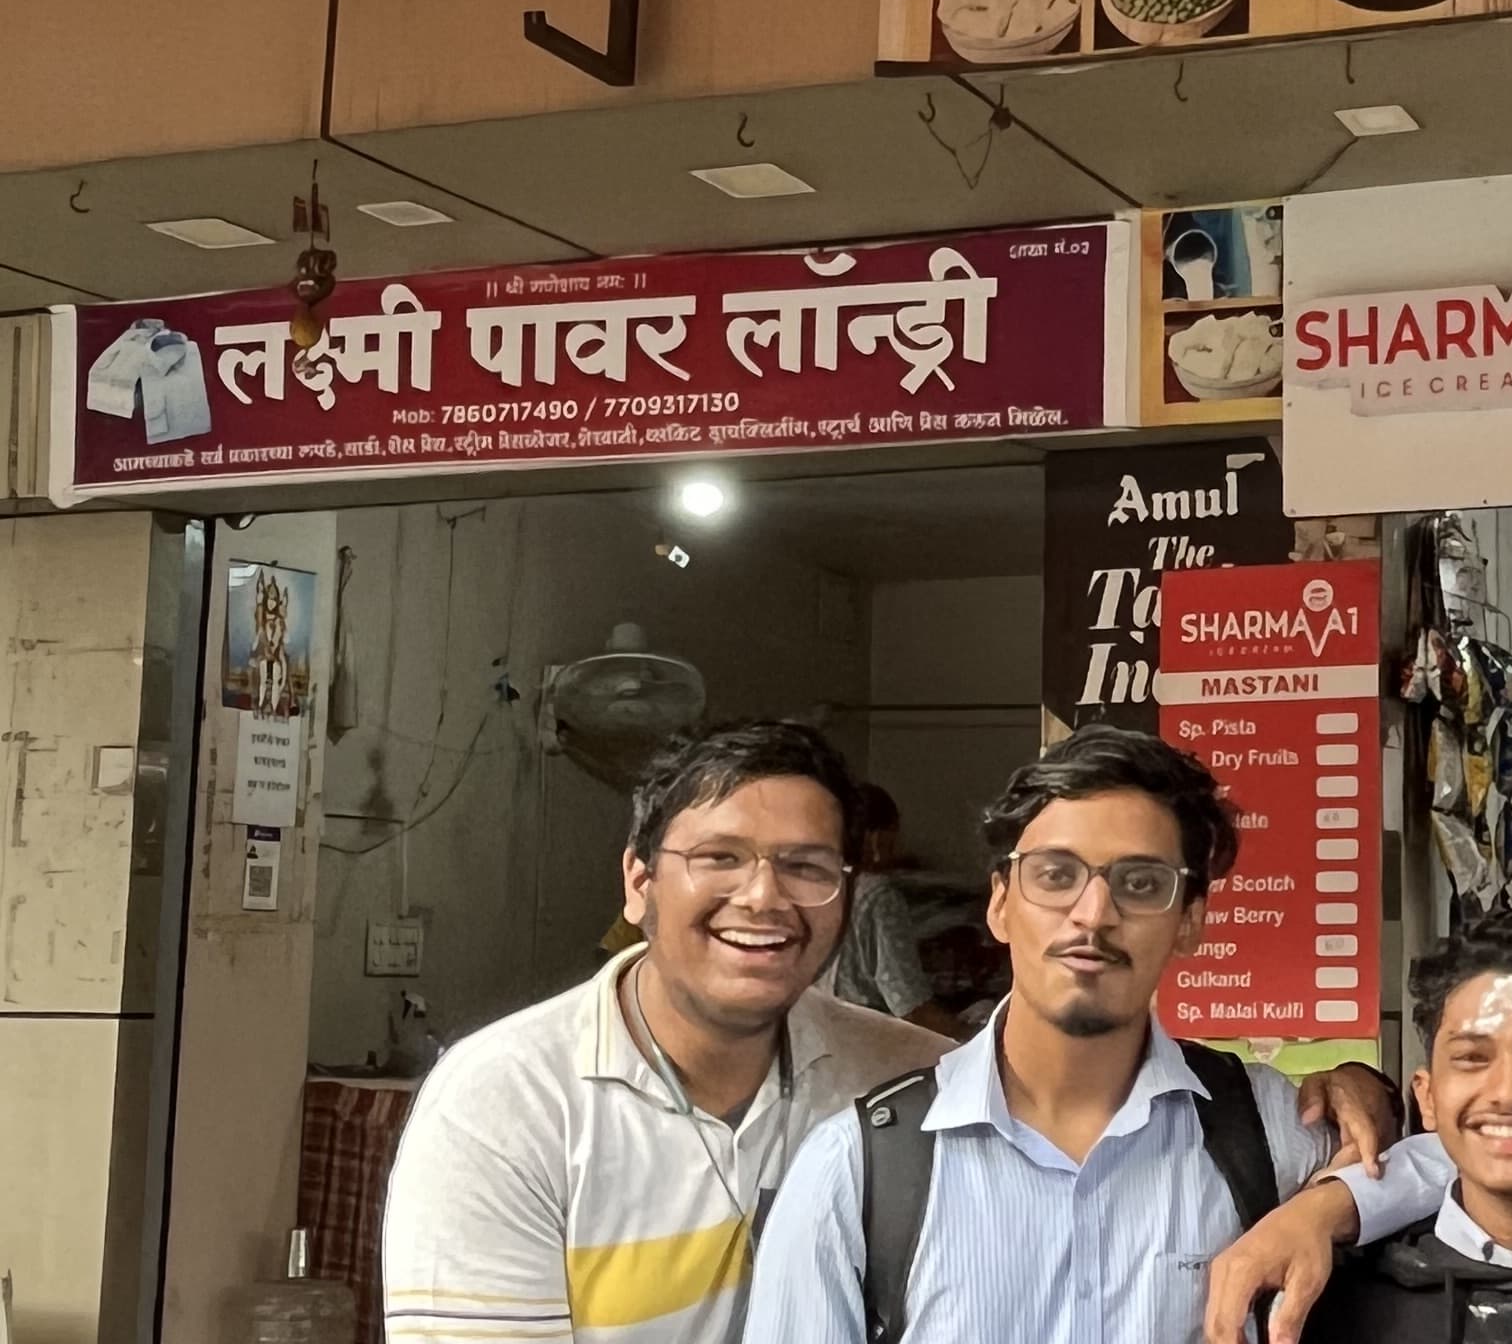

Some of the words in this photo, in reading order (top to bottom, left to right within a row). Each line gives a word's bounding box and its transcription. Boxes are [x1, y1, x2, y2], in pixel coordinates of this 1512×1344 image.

[505, 275, 524, 294] श्री
[530, 274, 590, 293] गणेशाय
[214, 283, 442, 411] लक्ष्मी
[466, 294, 697, 388] पावर
[722, 247, 998, 395] लॉन्ड्री
[1360, 377, 1413, 399] ICE
[392, 408, 435, 425] Mob:
[441, 400, 578, 425] 7860717490
[604, 392, 740, 418] 7709317130
[1108, 471, 1239, 527] Amul
[1148, 535, 1216, 571] The
[1201, 673, 1319, 697] MASTANI
[1178, 719, 1206, 740] Sp.
[1212, 719, 1257, 736] Pista
[1211, 750, 1243, 770] Dry
[1248, 748, 1300, 766] Fruits
[1232, 874, 1295, 892] Scotch
[1233, 906, 1285, 927] Berry
[1193, 942, 1238, 959] ango
[1177, 971, 1252, 989] Gulkand
[1210, 1001, 1258, 1019] Malai
